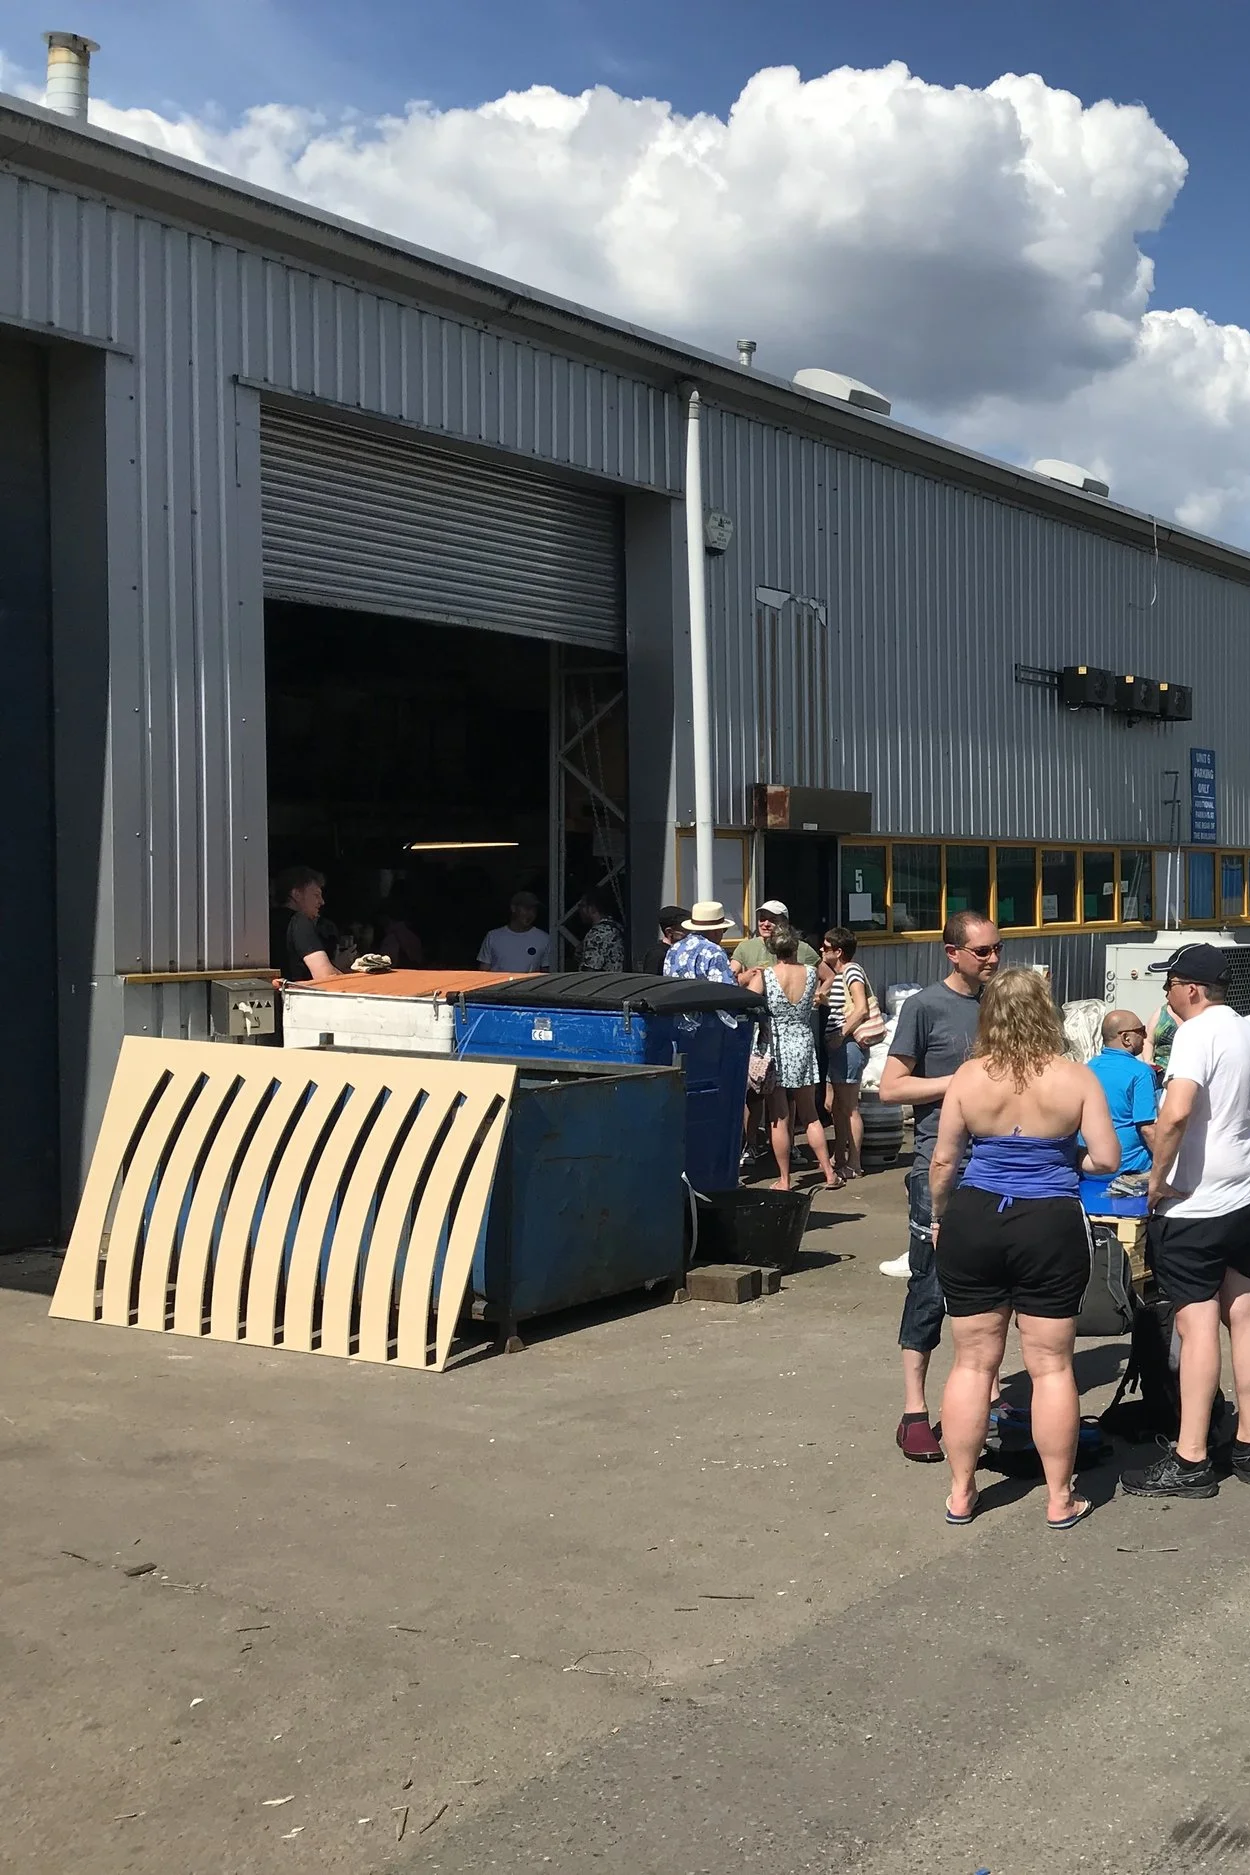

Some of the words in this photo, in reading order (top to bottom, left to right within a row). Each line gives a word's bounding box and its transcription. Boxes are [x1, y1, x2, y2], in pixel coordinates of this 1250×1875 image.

[1193, 767, 1214, 780] PARKING
[1197, 783, 1210, 794] ONLY
[855, 869, 863, 893] 5
